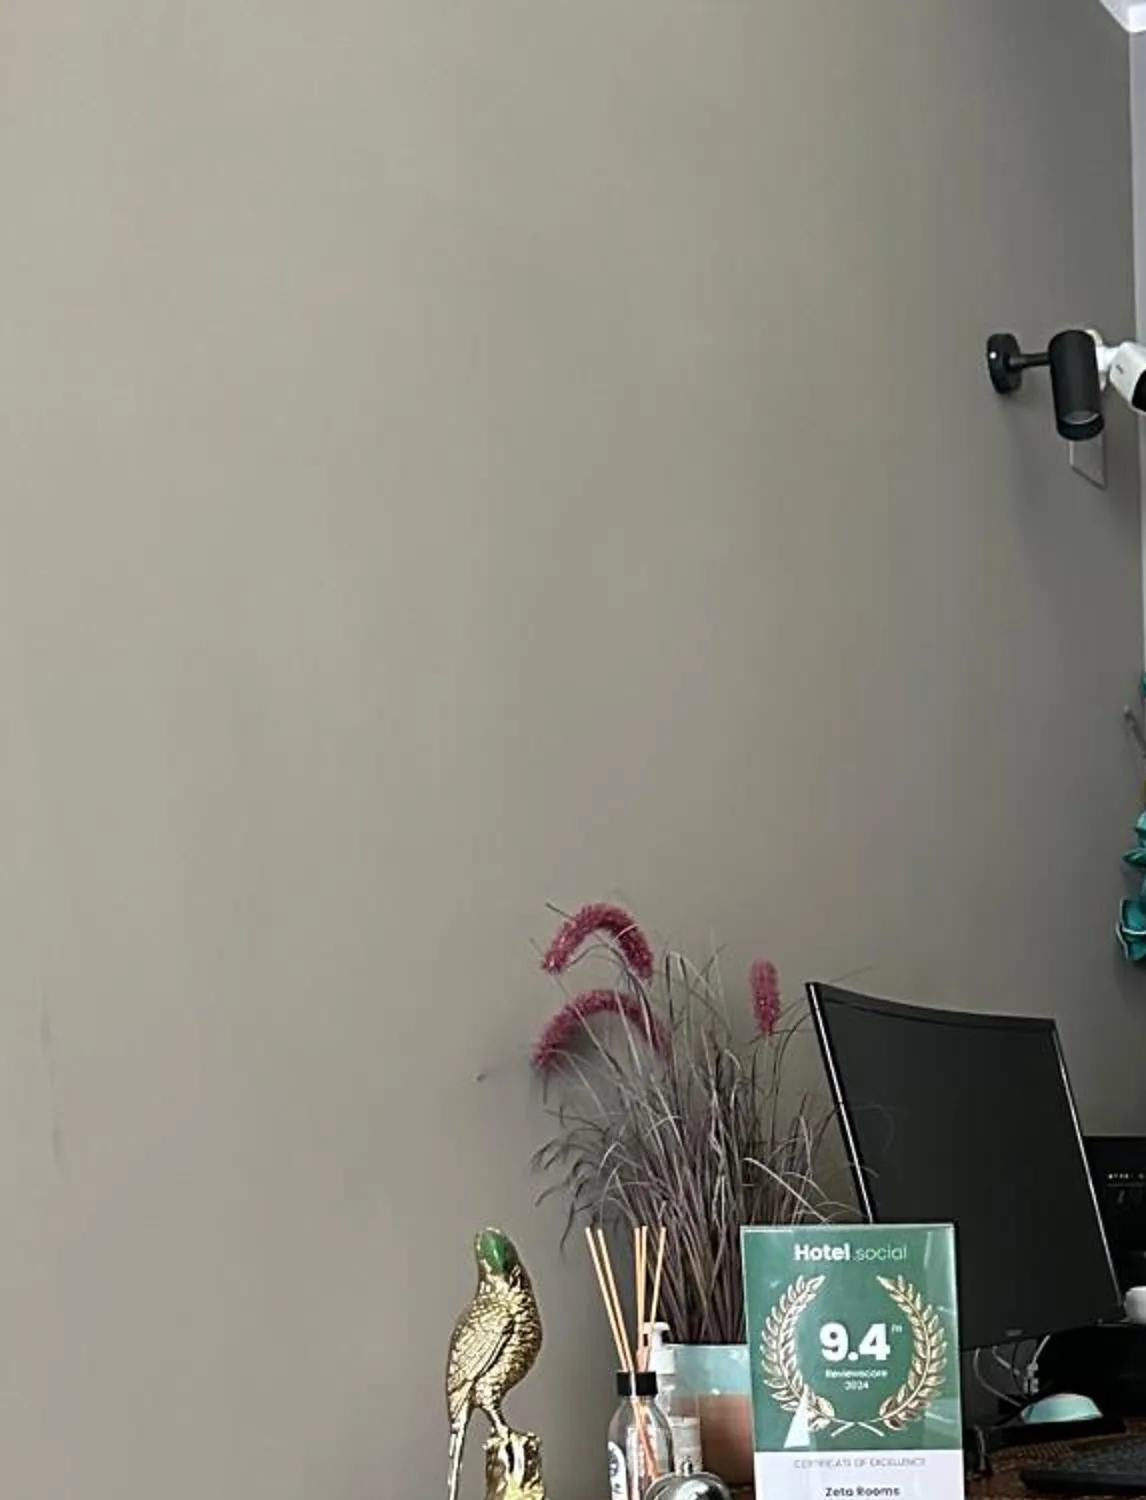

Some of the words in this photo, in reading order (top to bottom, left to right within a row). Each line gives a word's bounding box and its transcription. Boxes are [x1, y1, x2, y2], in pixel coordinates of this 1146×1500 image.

[819, 1322, 891, 1362] 9.4
[825, 1486, 854, 1497] Zeta
[856, 1486, 901, 1497] Rooms
